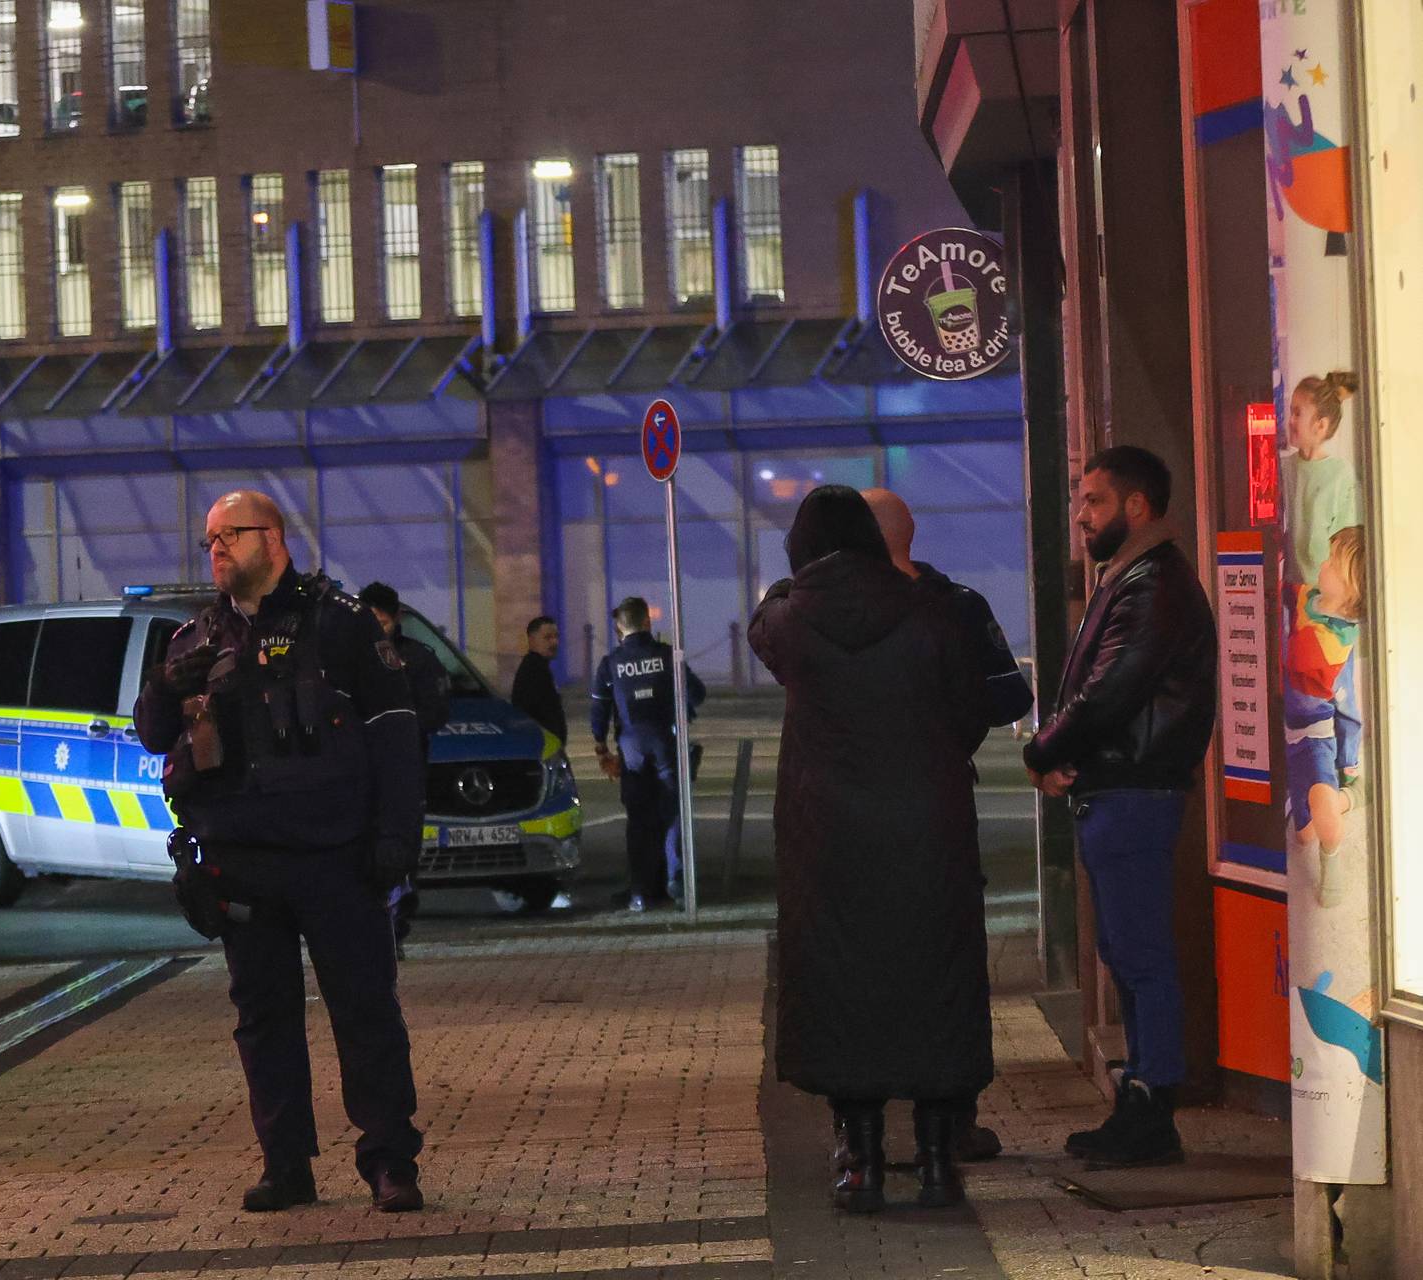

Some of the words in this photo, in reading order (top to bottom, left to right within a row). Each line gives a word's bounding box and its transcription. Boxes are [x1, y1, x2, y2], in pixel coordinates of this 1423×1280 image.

[886, 242, 1007, 295] TeAmore
[886, 311, 932, 367] bubble
[935, 355, 967, 373] tea
[969, 351, 986, 368] &
[985, 316, 1009, 357] drin
[617, 658, 665, 679] POLIZEI
